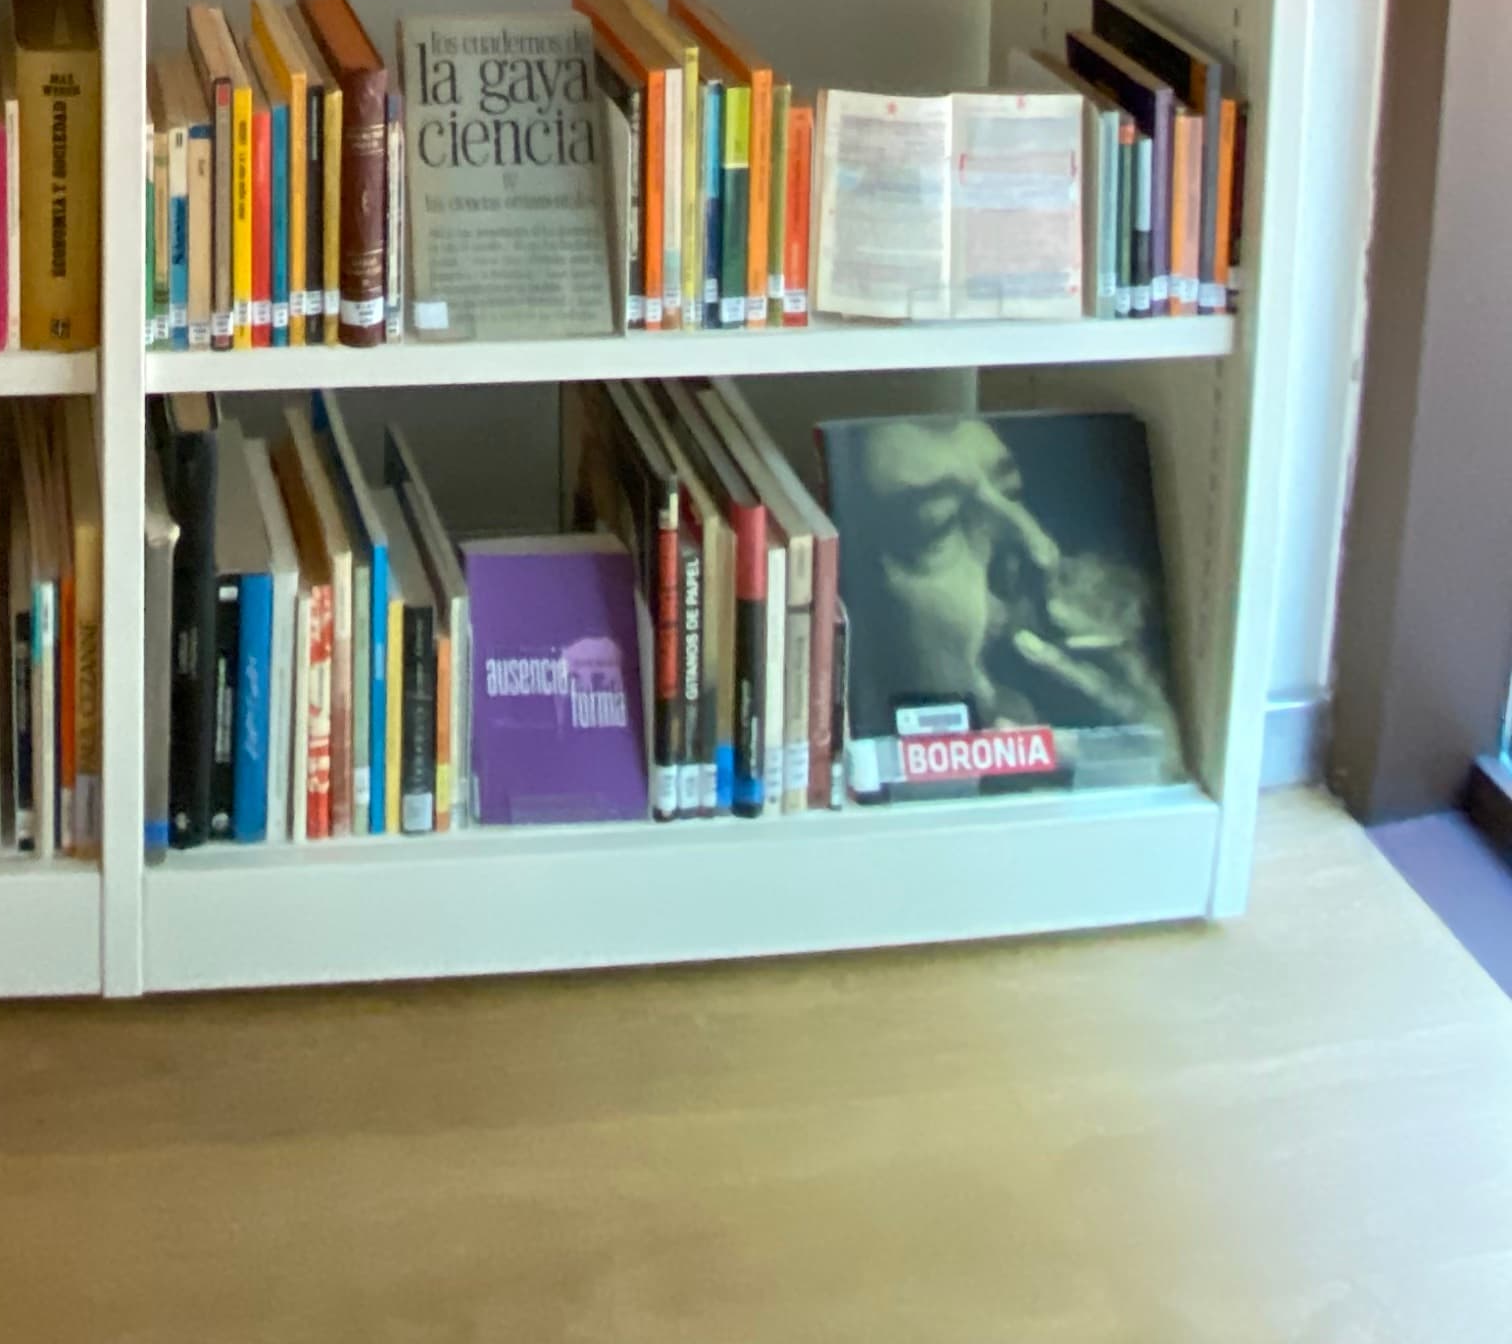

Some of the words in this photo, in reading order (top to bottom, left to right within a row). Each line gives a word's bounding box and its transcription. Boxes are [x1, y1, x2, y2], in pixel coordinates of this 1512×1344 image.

[431, 26, 457, 54] los
[462, 26, 562, 55] cuadernos
[417, 42, 461, 106] la
[479, 58, 593, 118] gaya
[418, 109, 598, 169] ciencia
[686, 557, 700, 606] PAPEL
[686, 608, 699, 631] DE
[486, 649, 569, 698] ausencia
[685, 634, 699, 700] GITANOS
[571, 677, 627, 728] forma
